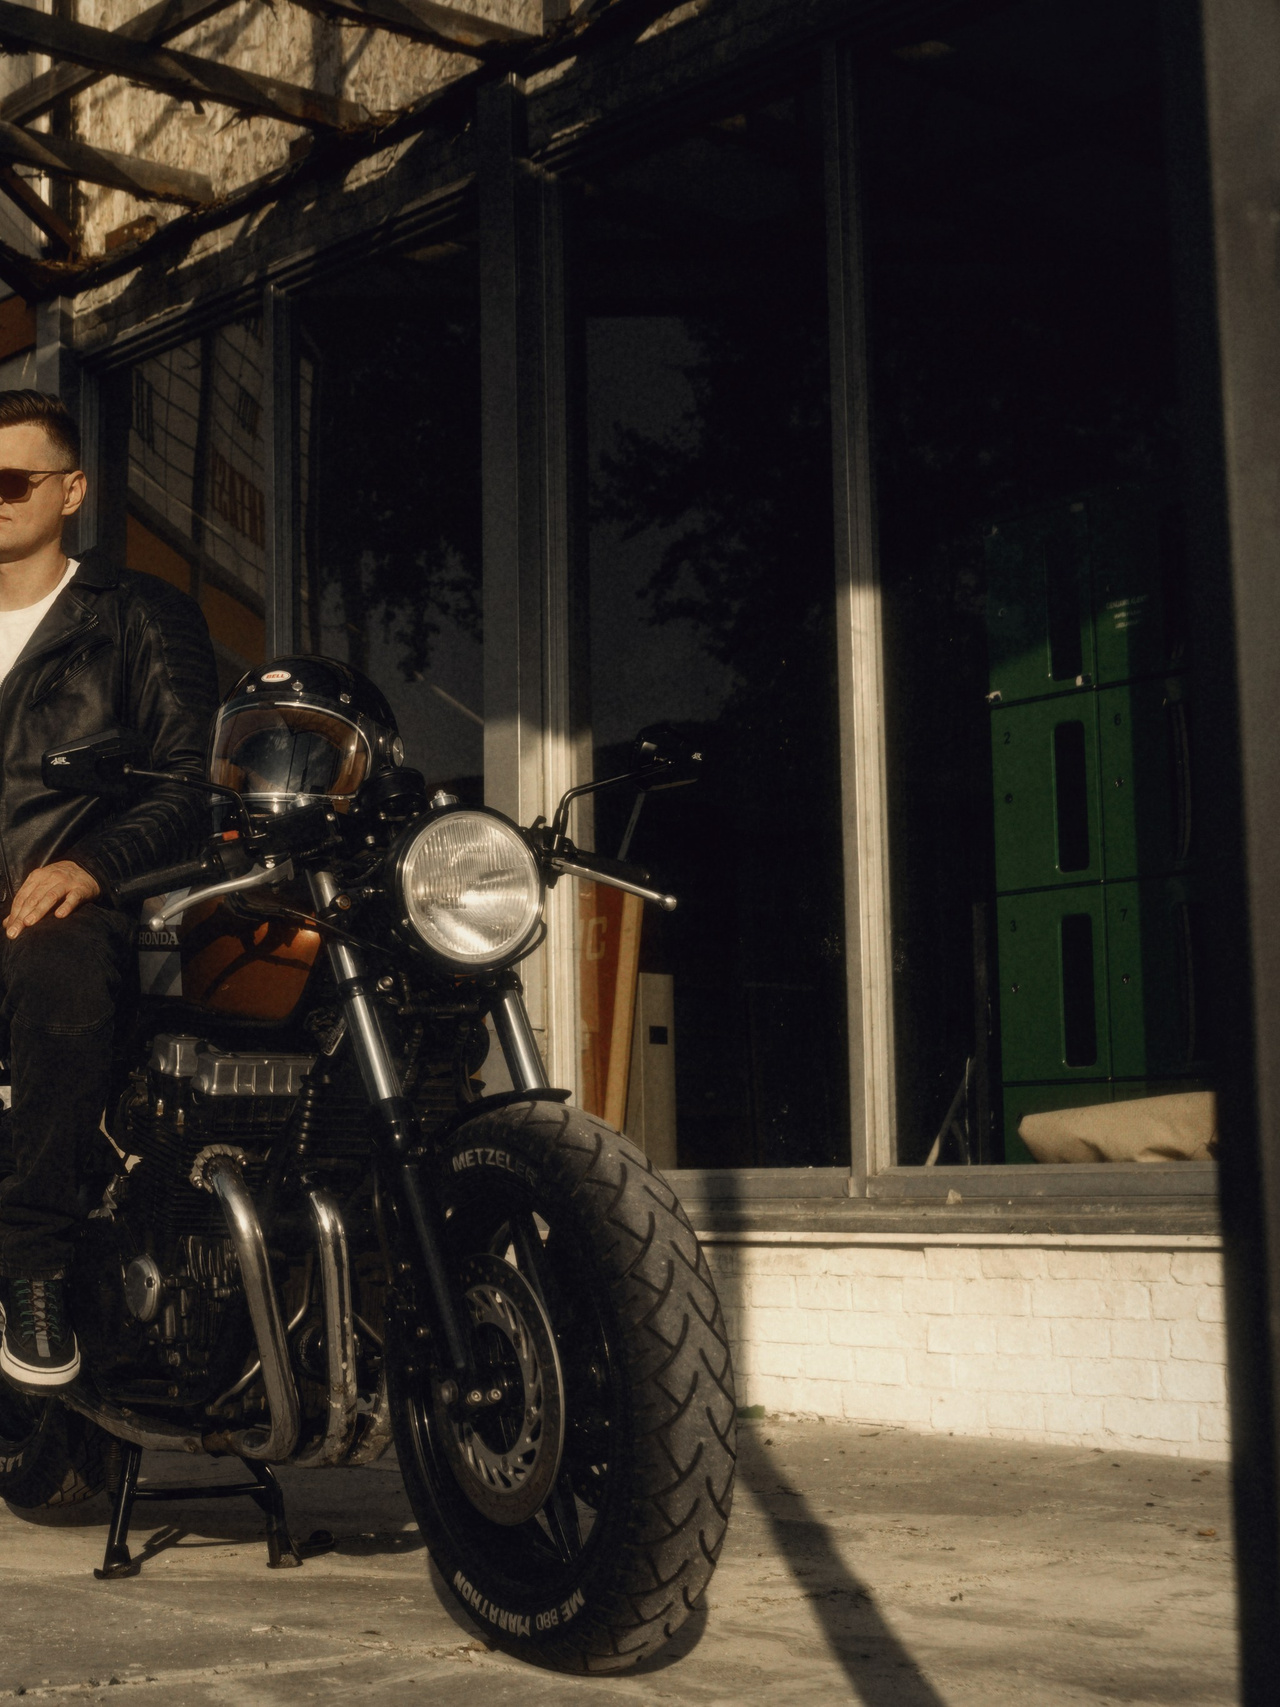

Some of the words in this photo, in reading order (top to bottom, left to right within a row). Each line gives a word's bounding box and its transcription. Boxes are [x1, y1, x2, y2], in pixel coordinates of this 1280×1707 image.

[1114, 712, 1122, 725] 6
[1003, 731, 1011, 745] 2
[1120, 908, 1128, 922] 7
[1010, 919, 1017, 933] 3
[138, 931, 180, 946] HONDA
[453, 1148, 538, 1187] METZELER
[452, 1570, 531, 1637] MARATHON
[560, 1587, 586, 1622] ME
[535, 1607, 559, 1631] 880
